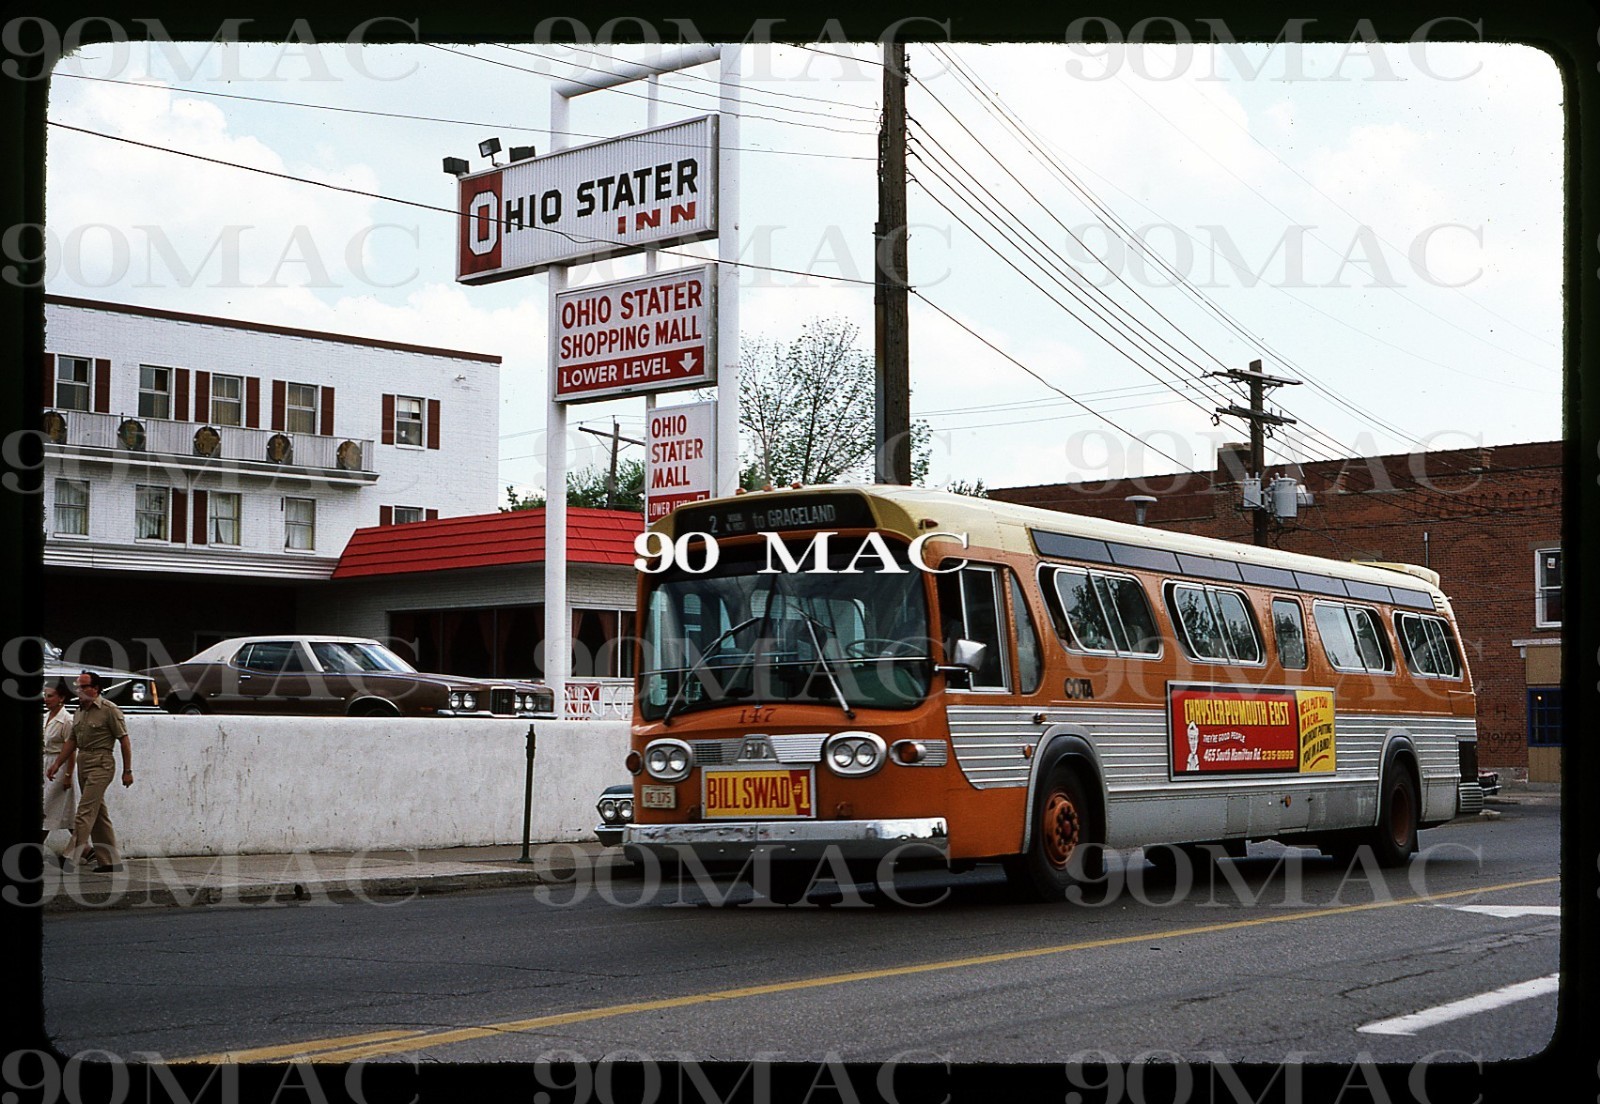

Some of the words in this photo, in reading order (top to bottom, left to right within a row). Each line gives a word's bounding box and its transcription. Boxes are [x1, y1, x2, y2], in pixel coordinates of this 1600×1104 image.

[469, 189, 562, 256] OHIO
[577, 158, 698, 217] STATER
[617, 201, 696, 235] INN
[562, 295, 612, 329] OHIO
[621, 280, 702, 319] STATER
[561, 324, 649, 359] SHOPPING
[655, 315, 702, 346] MALL
[563, 364, 617, 388] LOWER
[623, 357, 671, 379] LEVEL
[651, 414, 687, 438] OHIO
[651, 438, 704, 464] STATER
[651, 465, 690, 489] MALL
[649, 501, 671, 516] LOWER
[709, 515, 718, 533] 2
[767, 504, 837, 527] GRACELAND
[1064, 677, 1094, 699] COTA
[738, 708, 776, 724] 147
[1268, 701, 1290, 726] EAST
[707, 777, 740, 809] BILL
[743, 776, 790, 809] SWAD
